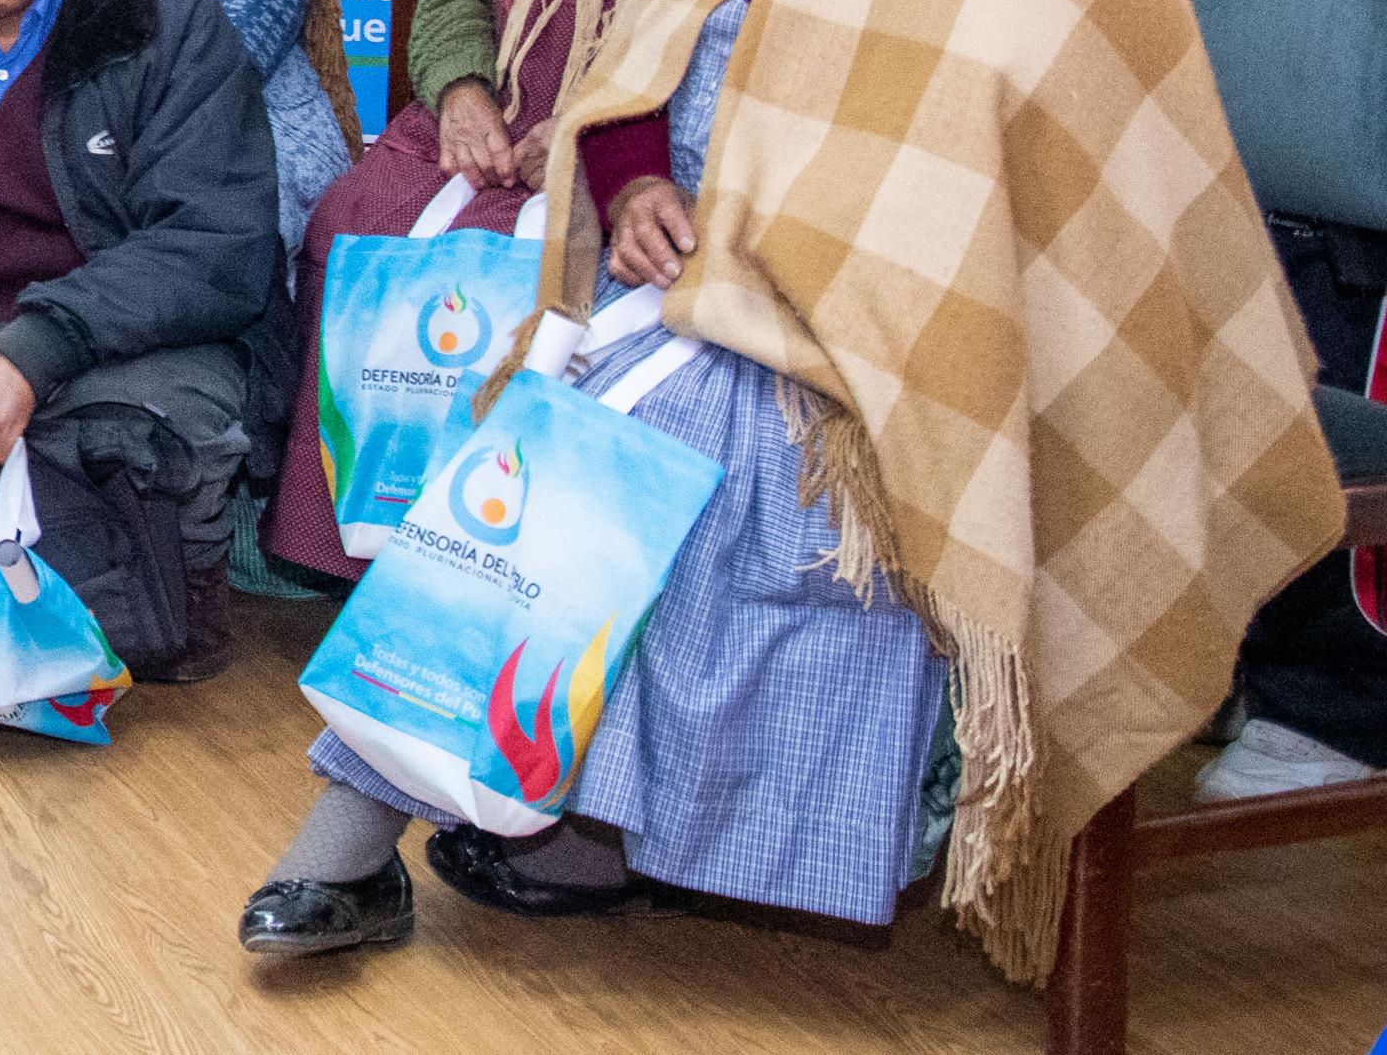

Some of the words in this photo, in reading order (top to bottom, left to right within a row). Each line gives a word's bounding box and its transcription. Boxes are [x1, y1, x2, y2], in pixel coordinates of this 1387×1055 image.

[362, 368, 442, 386] DEFENSORÍA
[482, 553, 509, 577] DEL
[354, 654, 432, 697] Defensores
